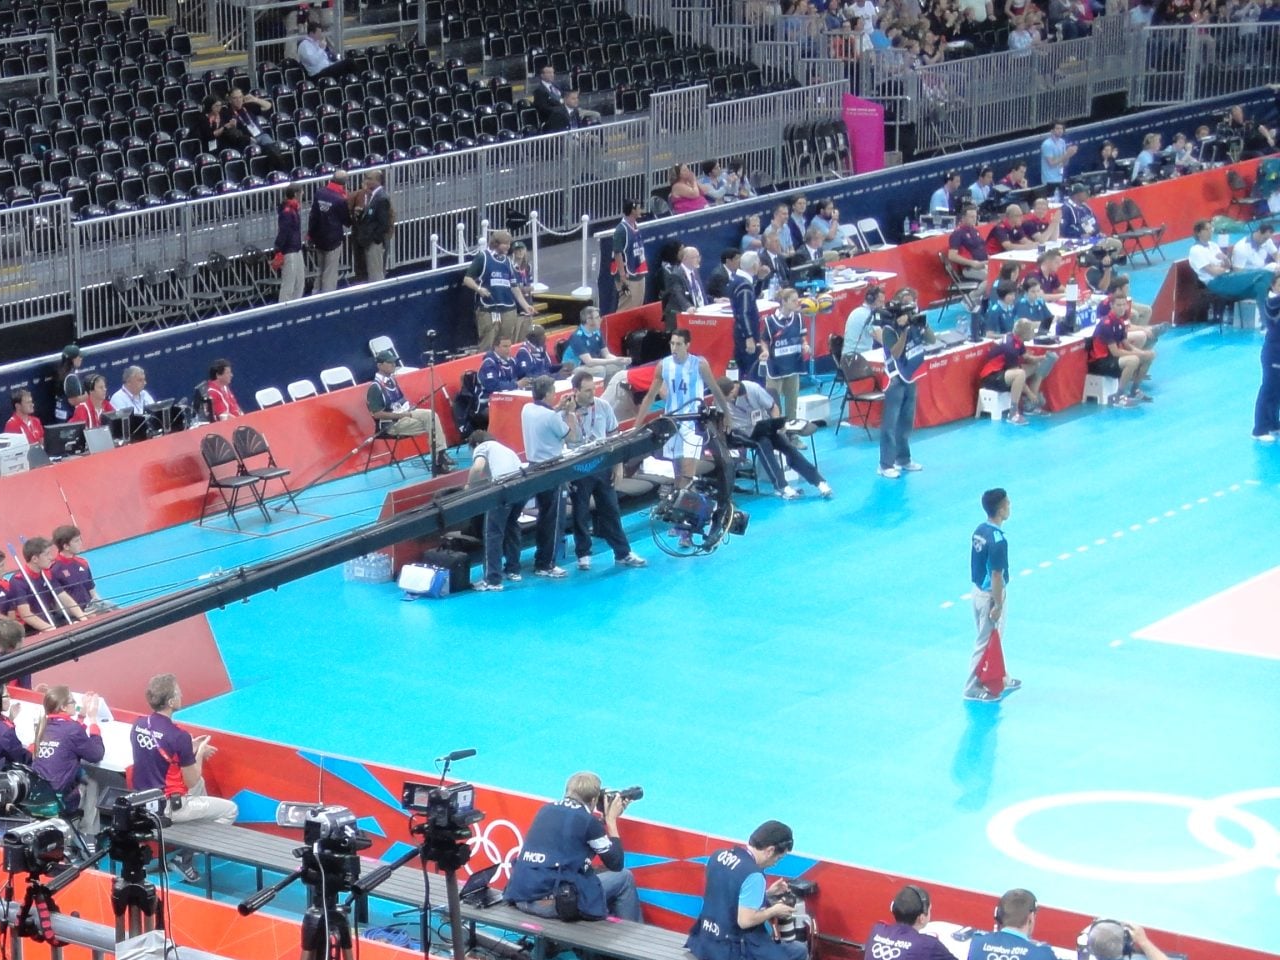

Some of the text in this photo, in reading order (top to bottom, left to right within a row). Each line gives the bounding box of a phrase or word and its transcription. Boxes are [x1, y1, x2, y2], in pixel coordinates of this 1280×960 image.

[671, 378, 688, 395] 14
[716, 850, 741, 870] 0391
[873, 934, 912, 950] London 2012
[983, 943, 1029, 956] London 2012
